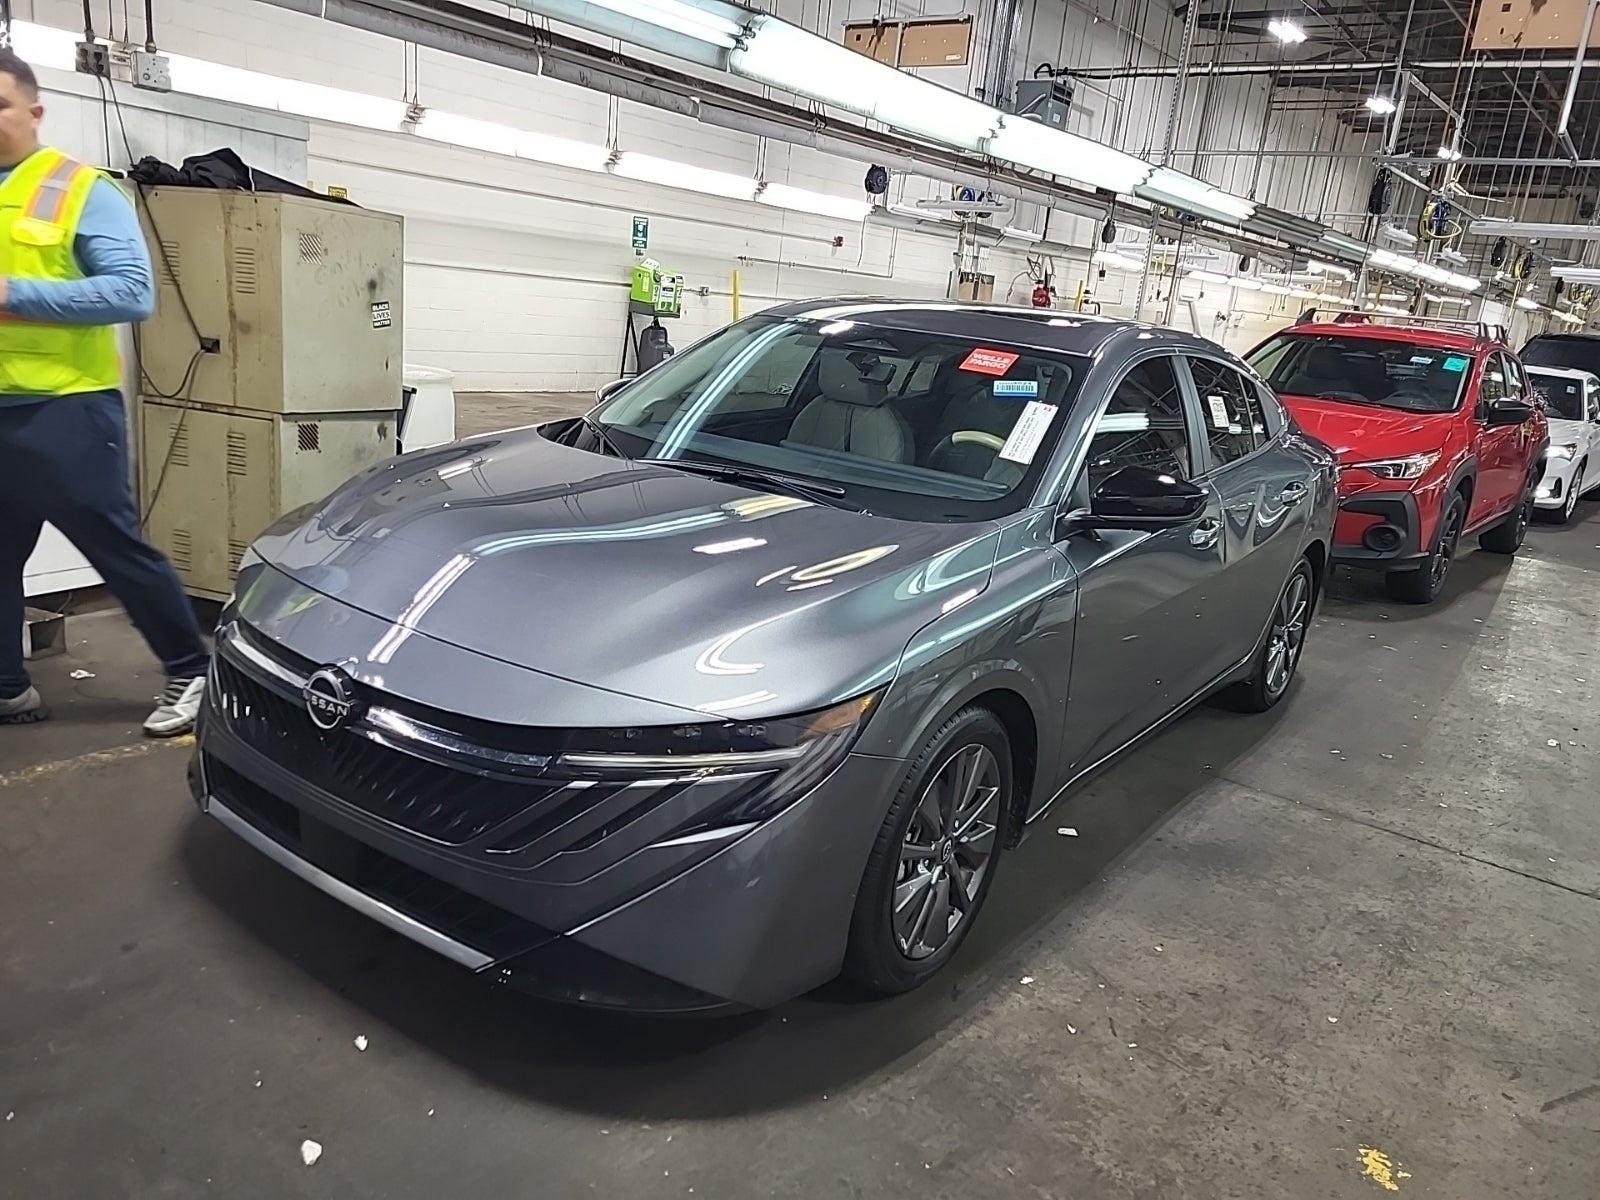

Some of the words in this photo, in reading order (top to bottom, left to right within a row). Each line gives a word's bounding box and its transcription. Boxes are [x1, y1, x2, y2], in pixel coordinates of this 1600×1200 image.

[373, 303, 389, 311] BLACK
[968, 358, 1007, 369] FARGO
[973, 353, 1011, 364] WELLS
[304, 690, 348, 717] SSAN
